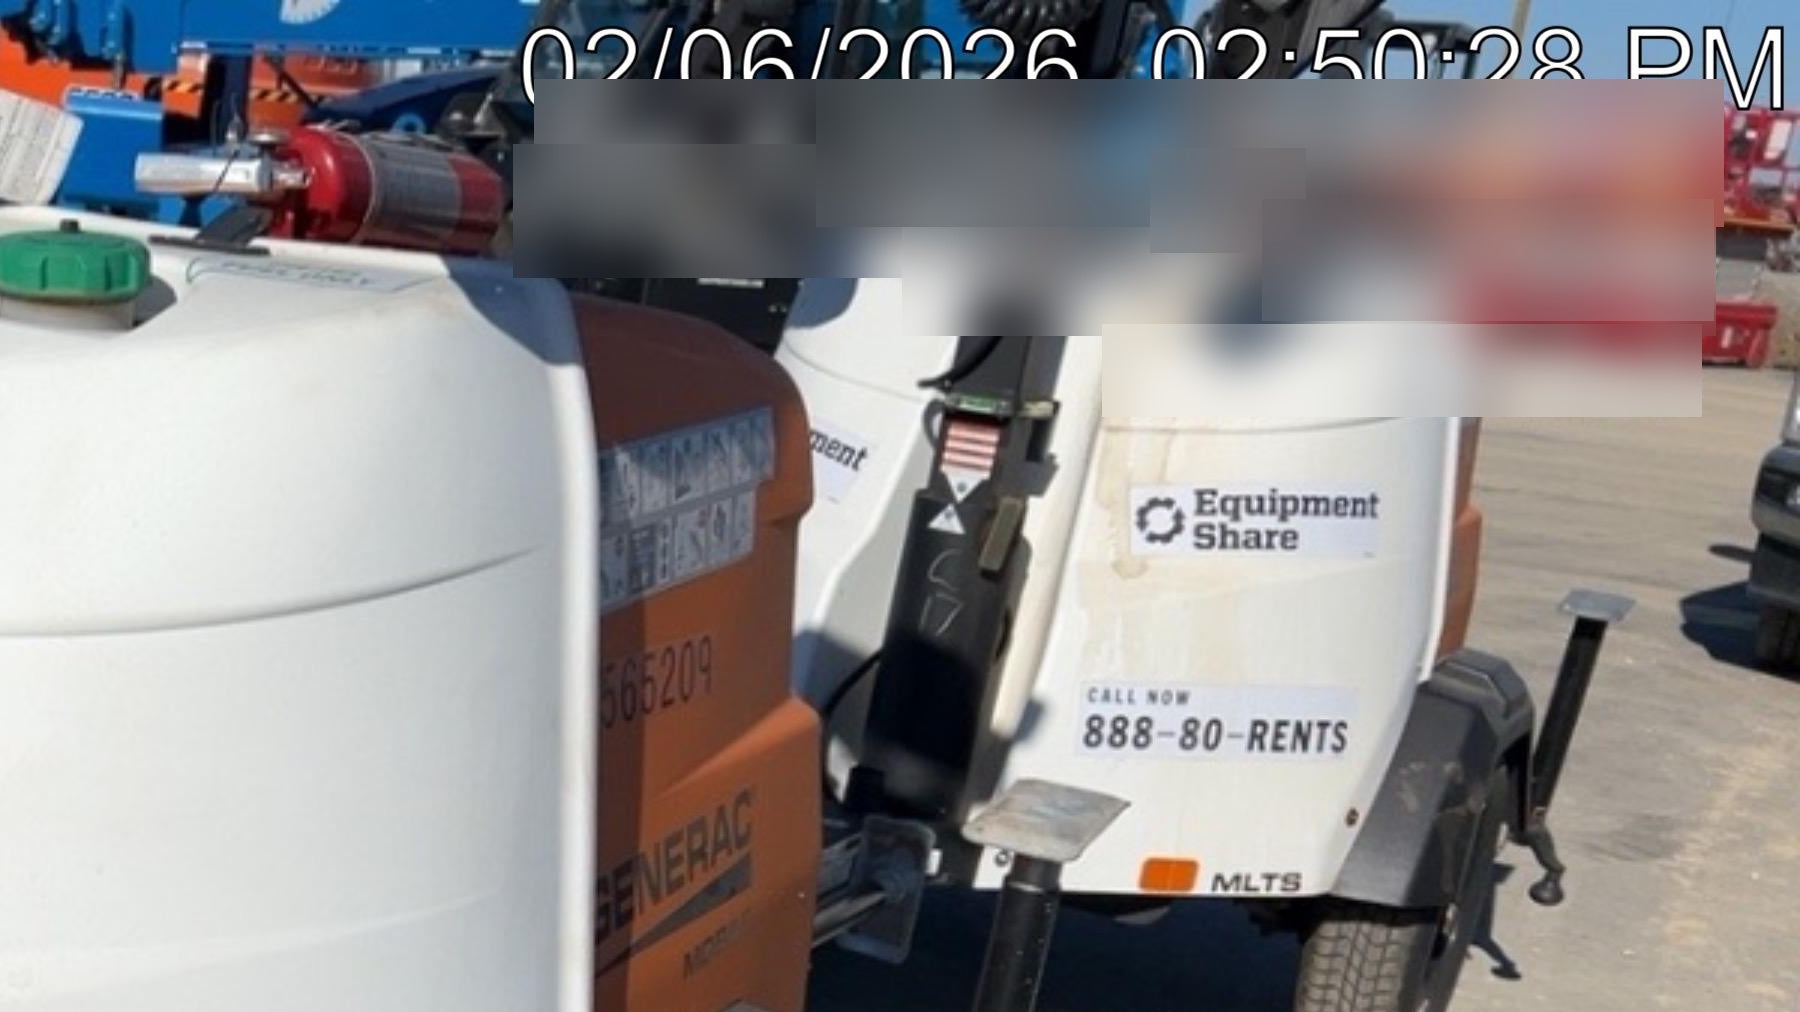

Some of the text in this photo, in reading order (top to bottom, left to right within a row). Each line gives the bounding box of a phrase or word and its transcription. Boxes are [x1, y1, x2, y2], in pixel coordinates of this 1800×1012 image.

[1193, 488, 1380, 522] Equipment
[1193, 522, 1299, 550] Share
[1087, 687, 1191, 705] CALL NOW
[1083, 714, 1349, 753] 888-80-RENTS
[1211, 871, 1303, 893] MLTS
